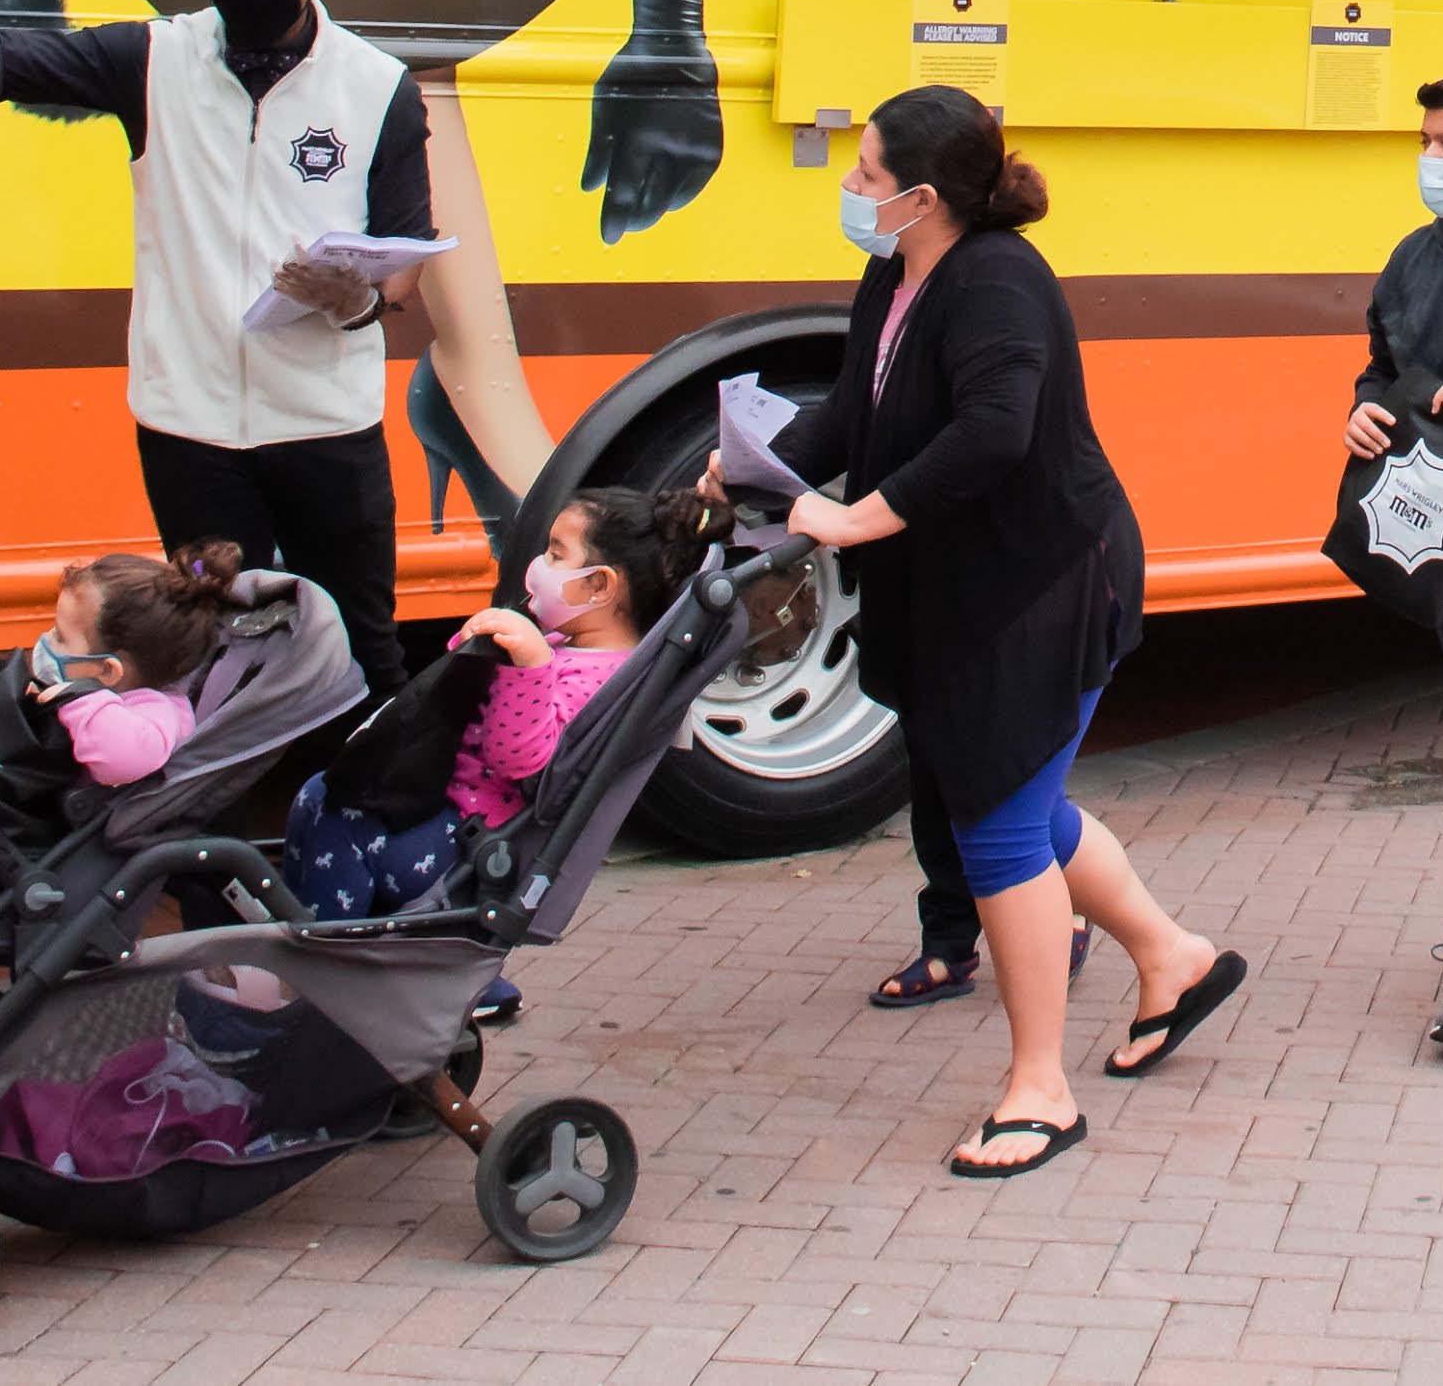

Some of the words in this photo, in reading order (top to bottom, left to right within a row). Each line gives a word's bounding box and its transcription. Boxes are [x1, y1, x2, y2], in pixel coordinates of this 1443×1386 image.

[923, 25, 958, 35] ALLERGY
[959, 26, 998, 35] WARNING
[923, 33, 952, 42] PLEASE
[953, 34, 963, 42] BE
[964, 34, 998, 43] ADVISED
[1334, 31, 1370, 43] NOTICE
[1394, 476, 1412, 495] MARS
